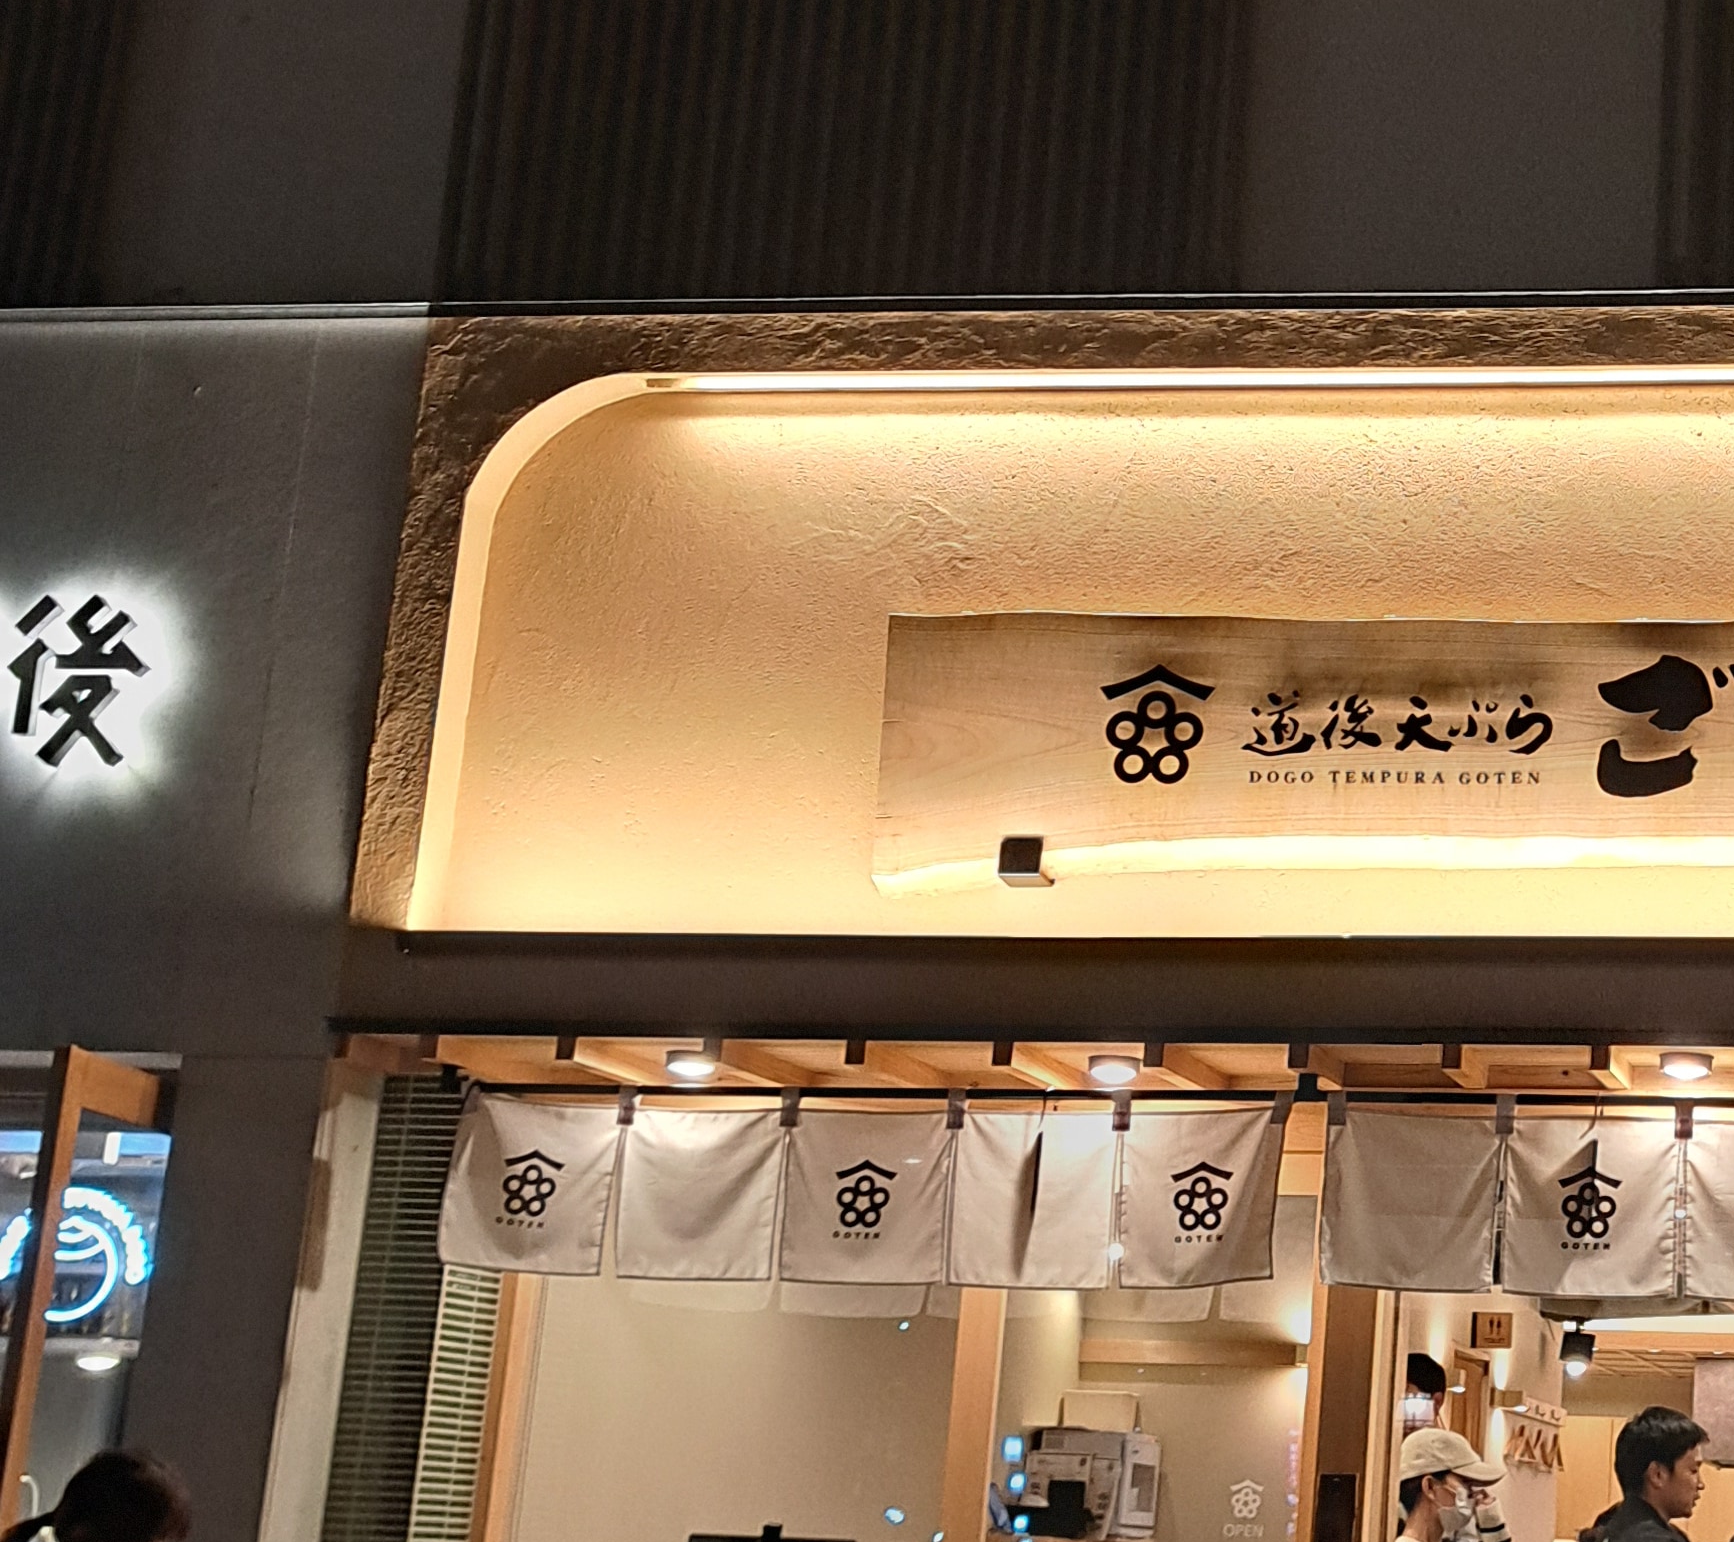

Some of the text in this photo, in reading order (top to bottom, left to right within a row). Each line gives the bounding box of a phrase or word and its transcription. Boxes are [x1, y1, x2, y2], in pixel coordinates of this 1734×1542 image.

[8, 594, 151, 768] 後
[1241, 690, 1553, 756] 道後天ぷら
[1249, 770, 1541, 785] DOGO TEMPURA GOTEN
[1223, 1523, 1265, 1537] OPEN
